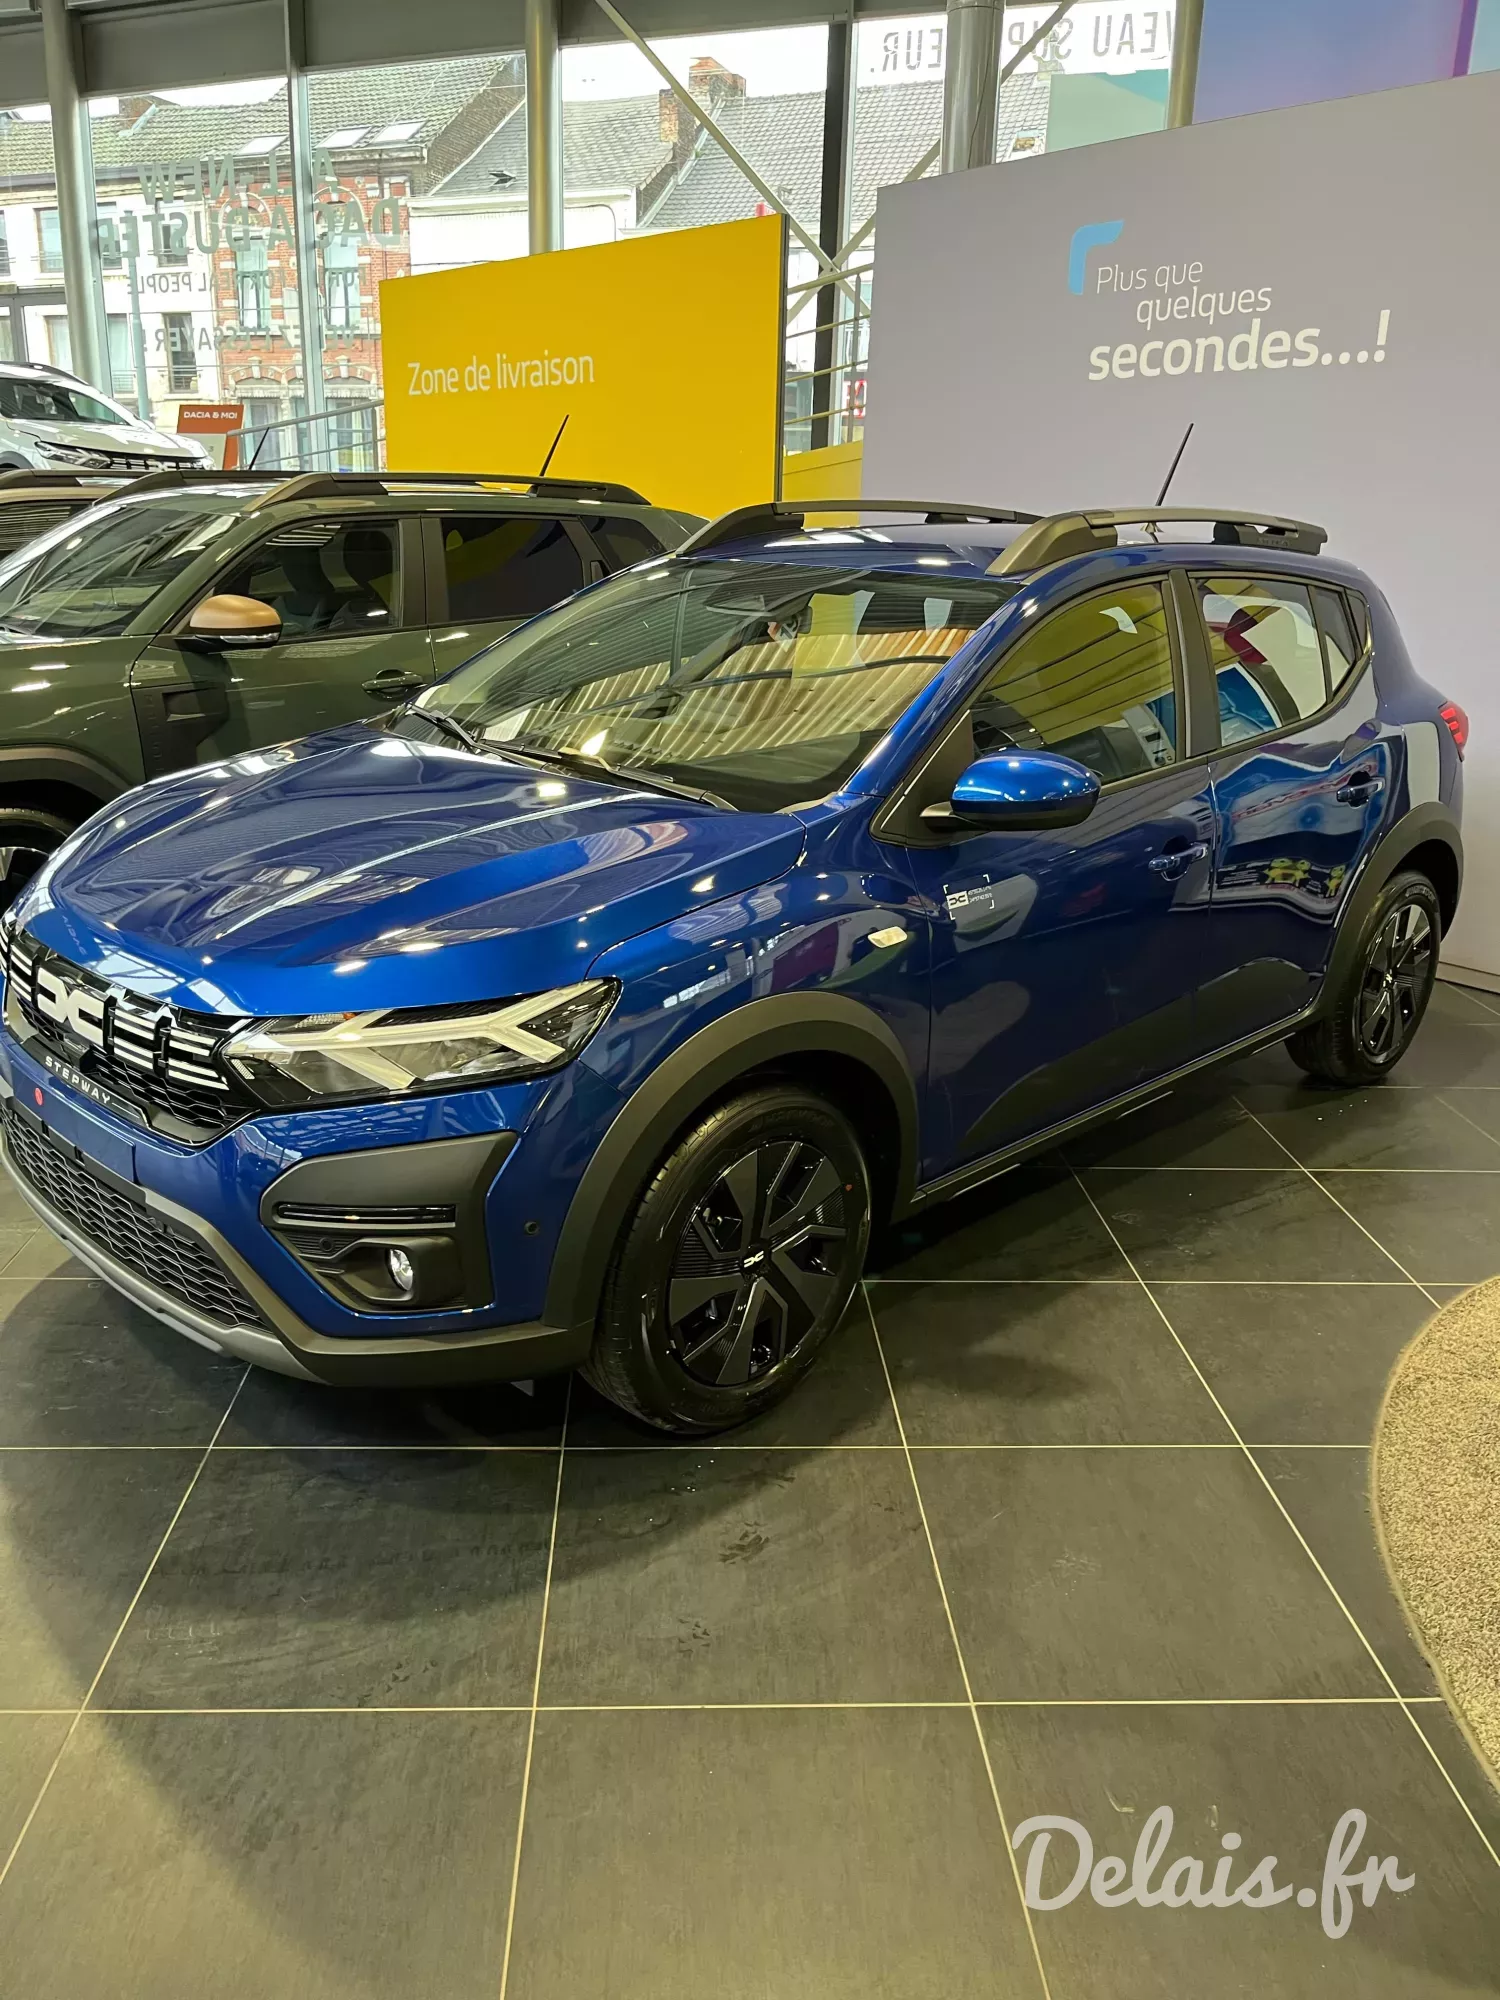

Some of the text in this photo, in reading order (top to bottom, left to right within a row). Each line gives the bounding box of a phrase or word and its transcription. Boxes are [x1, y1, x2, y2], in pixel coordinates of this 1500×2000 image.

[1096, 260, 1203, 294] Plus que
[1136, 285, 1272, 331] quelques
[407, 349, 595, 396] Zone de livraison
[183, 411, 211, 419] DACIA
[212, 411, 219, 419] &
[45, 1055, 111, 1104] STEPWAY
